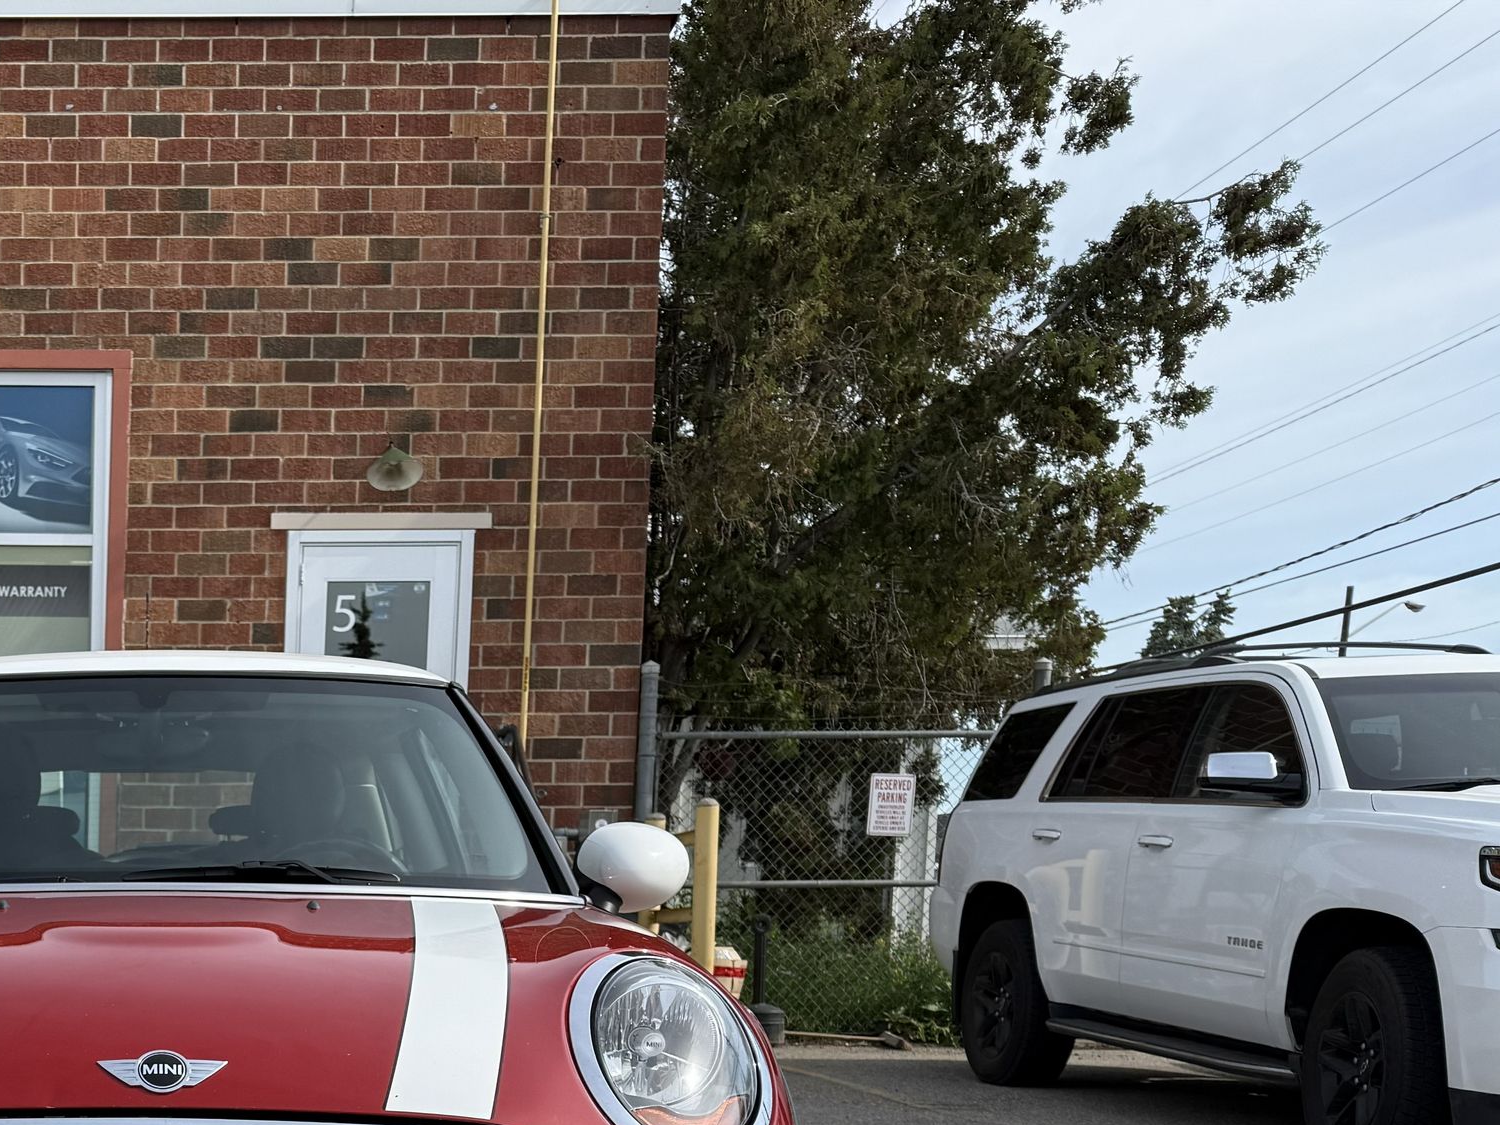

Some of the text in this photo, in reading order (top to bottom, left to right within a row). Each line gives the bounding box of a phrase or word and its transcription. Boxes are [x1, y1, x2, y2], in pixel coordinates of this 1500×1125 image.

[332, 595, 356, 632] 5
[875, 779, 911, 791] RESERVED
[878, 792, 907, 804] PARKING
[1226, 935, 1264, 950] TAHOE
[143, 1064, 182, 1075] MINI
